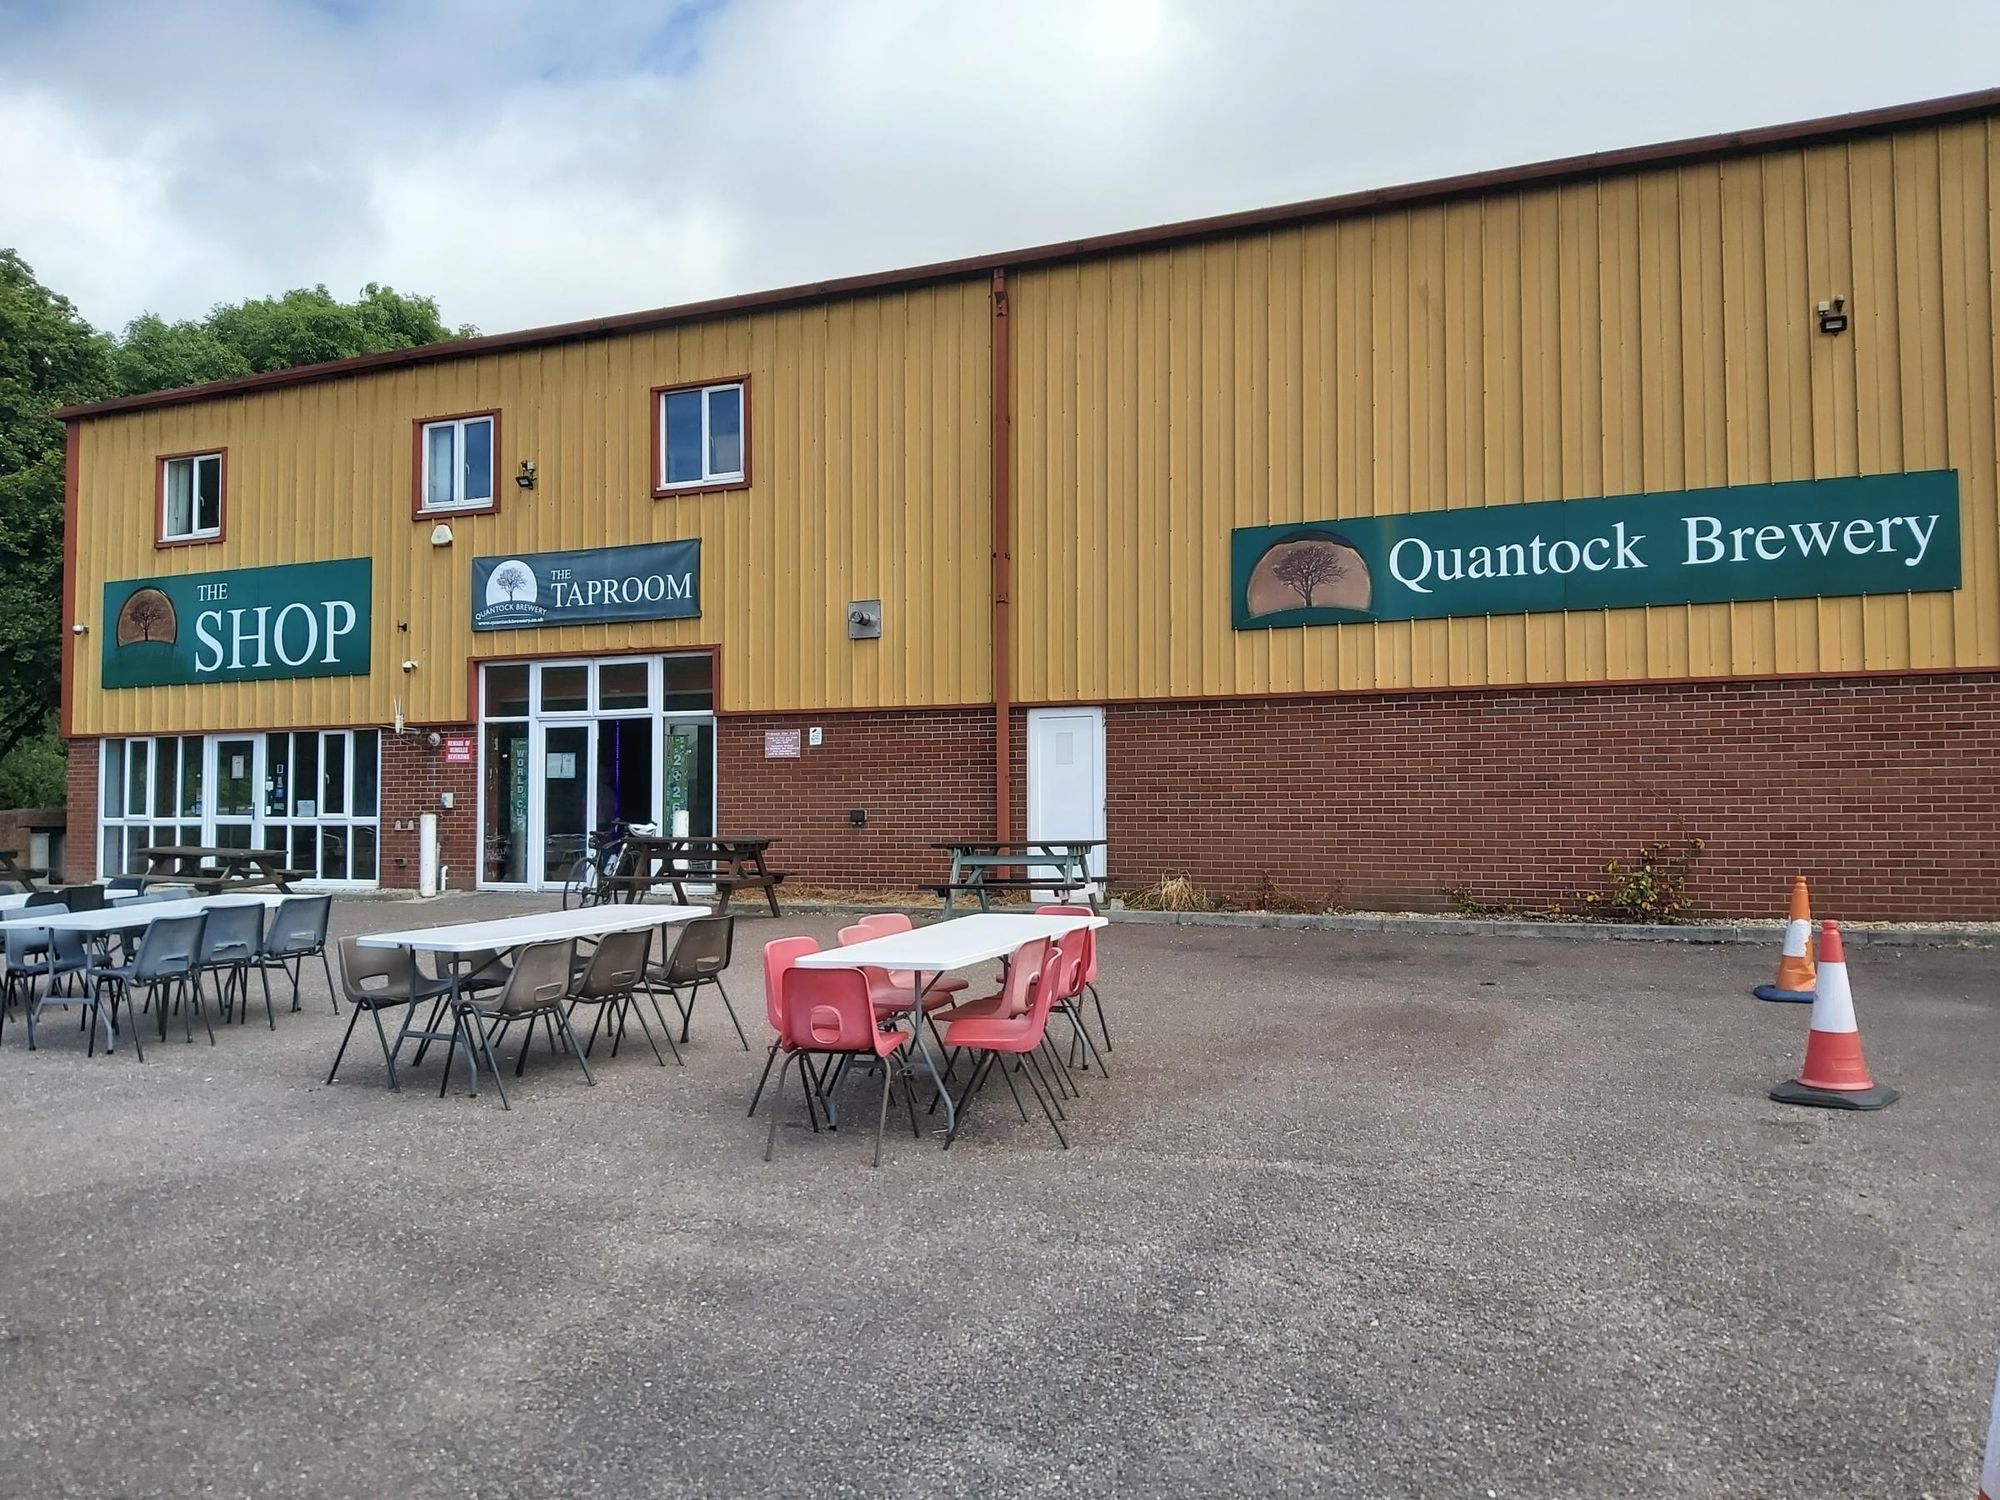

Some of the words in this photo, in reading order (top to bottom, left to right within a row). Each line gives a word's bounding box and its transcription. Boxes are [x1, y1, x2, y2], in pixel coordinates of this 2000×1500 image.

[1389, 521, 1648, 593] Quantock
[1682, 513, 1941, 568] Brewery
[550, 568, 572, 580] THE
[196, 582, 229, 602] THE
[550, 572, 693, 608] TAPROOM
[475, 603, 514, 620] QUANTOCK
[515, 603, 547, 616] BREWERY
[195, 600, 356, 673] SHOP
[516, 749, 524, 794] WORLD
[516, 800, 524, 826] CUP
